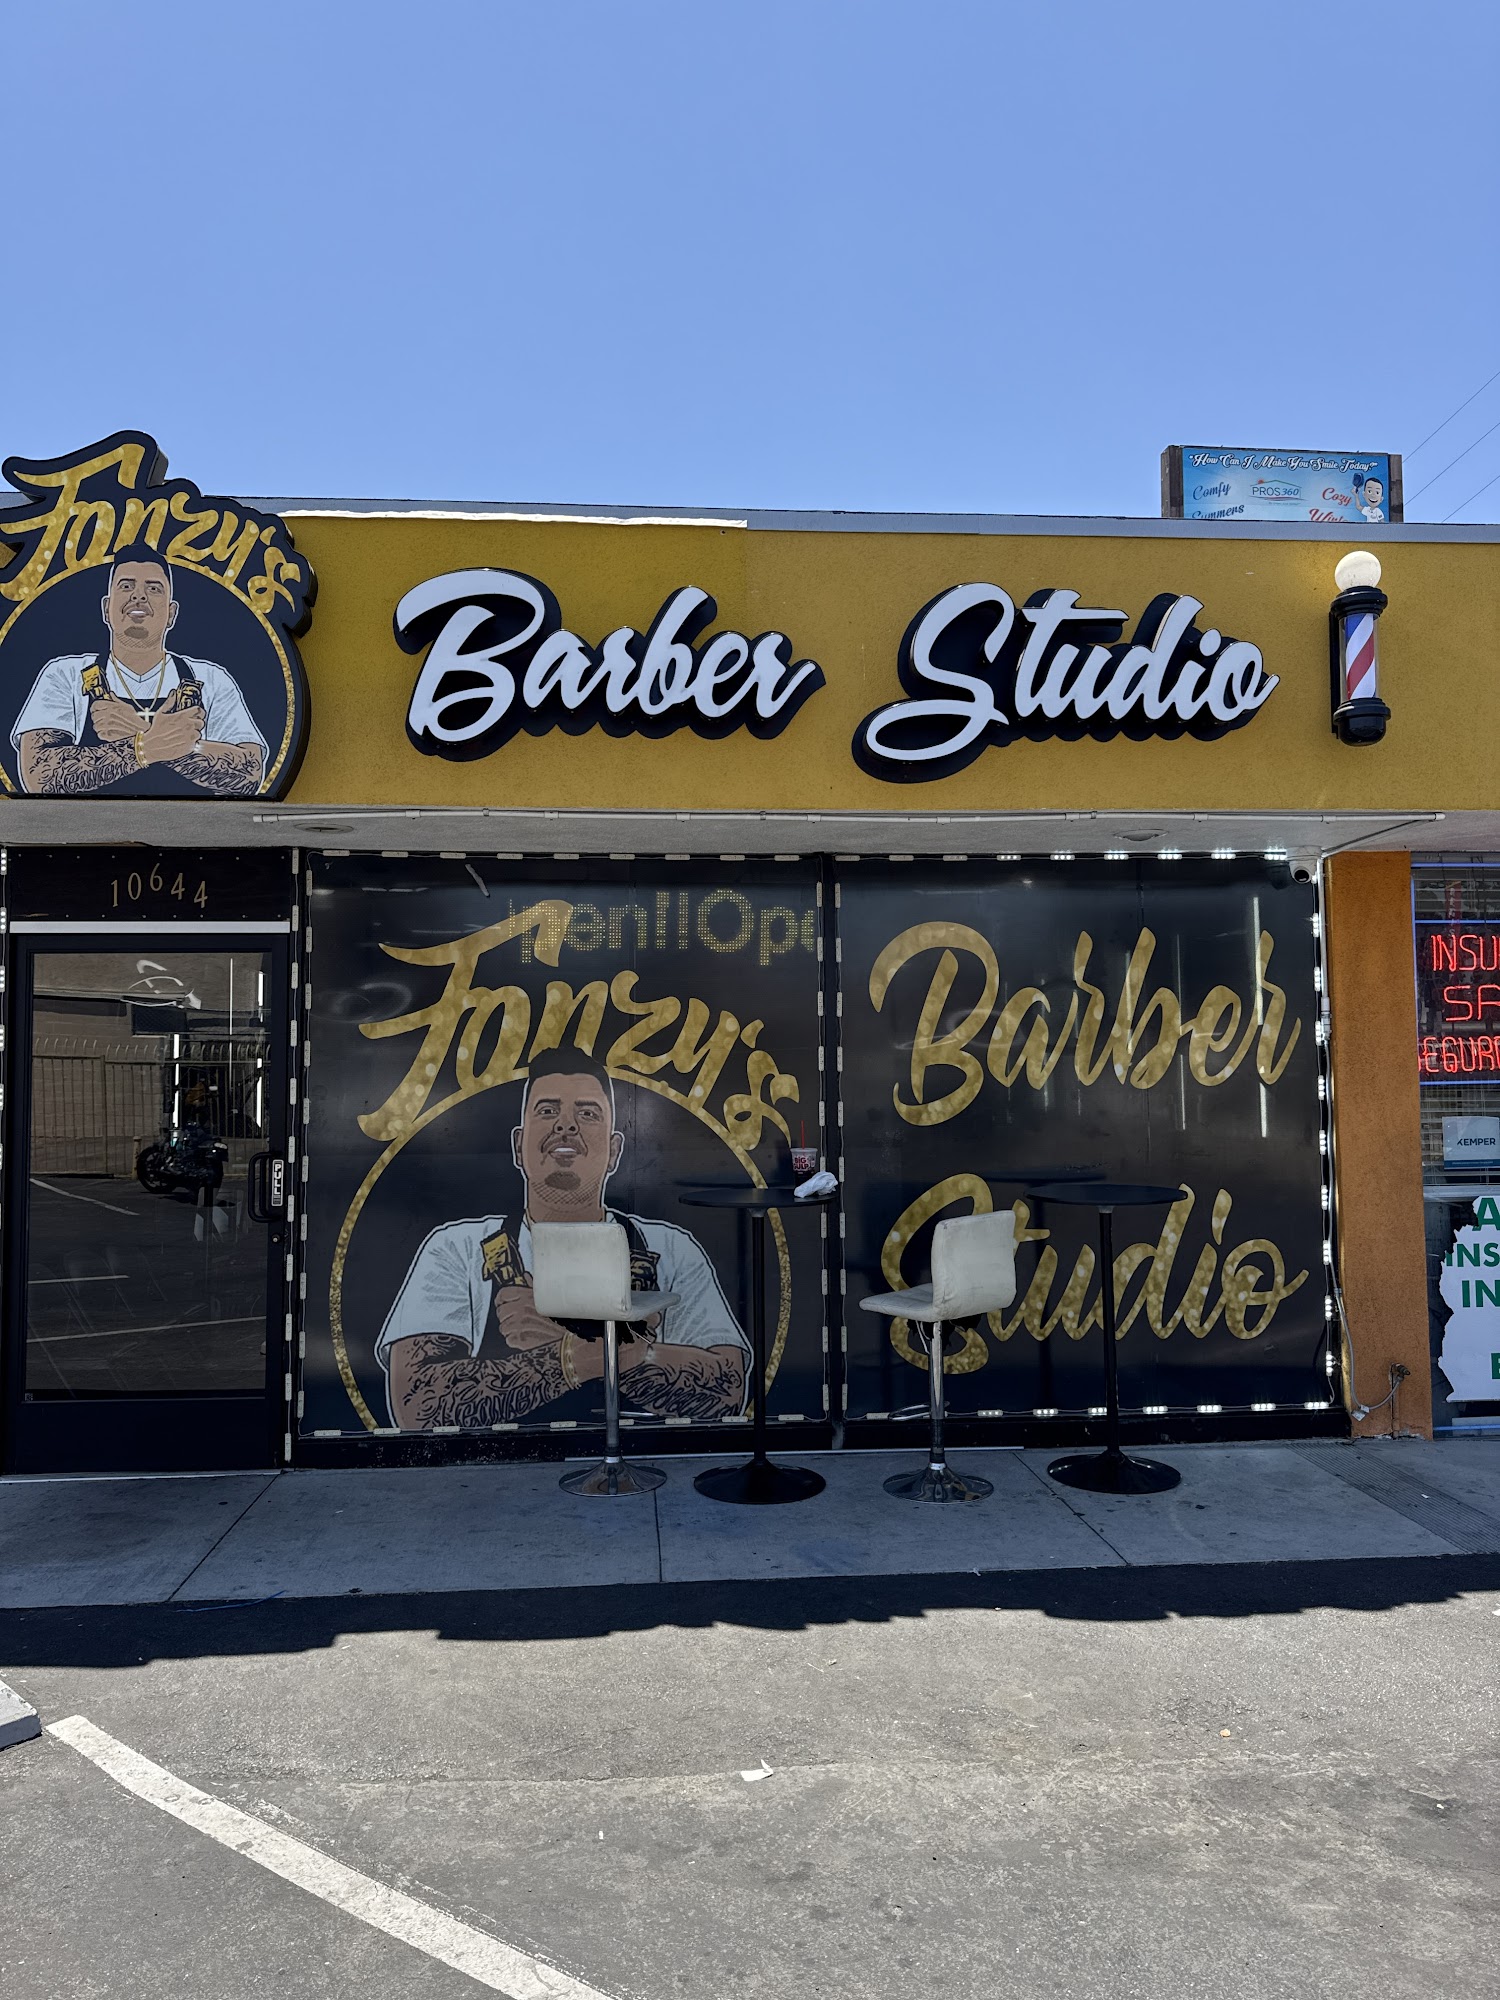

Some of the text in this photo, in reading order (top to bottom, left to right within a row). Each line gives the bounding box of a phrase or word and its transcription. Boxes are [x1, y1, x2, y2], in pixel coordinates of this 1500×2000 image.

[1219, 454, 1240, 468] Can
[1241, 455, 1255, 469] I
[1254, 456, 1287, 470] Make
[1287, 456, 1309, 471] You
[1309, 457, 1339, 471] Smile
[1192, 482, 1231, 501] Comfy
[1321, 487, 1352, 506] Cozy
[0, 443, 301, 614] Fonzy's
[397, 567, 1280, 761] Barber Studio
[110, 862, 209, 909] 10644
[1431, 935, 1500, 972] INSU
[357, 899, 800, 1151] Fonzy's
[869, 921, 1301, 1127] Barber
[1417, 1036, 1500, 1073] EGUR
[1456, 1137, 1497, 1147] KEMPER
[274, 1163, 283, 1195] PULL
